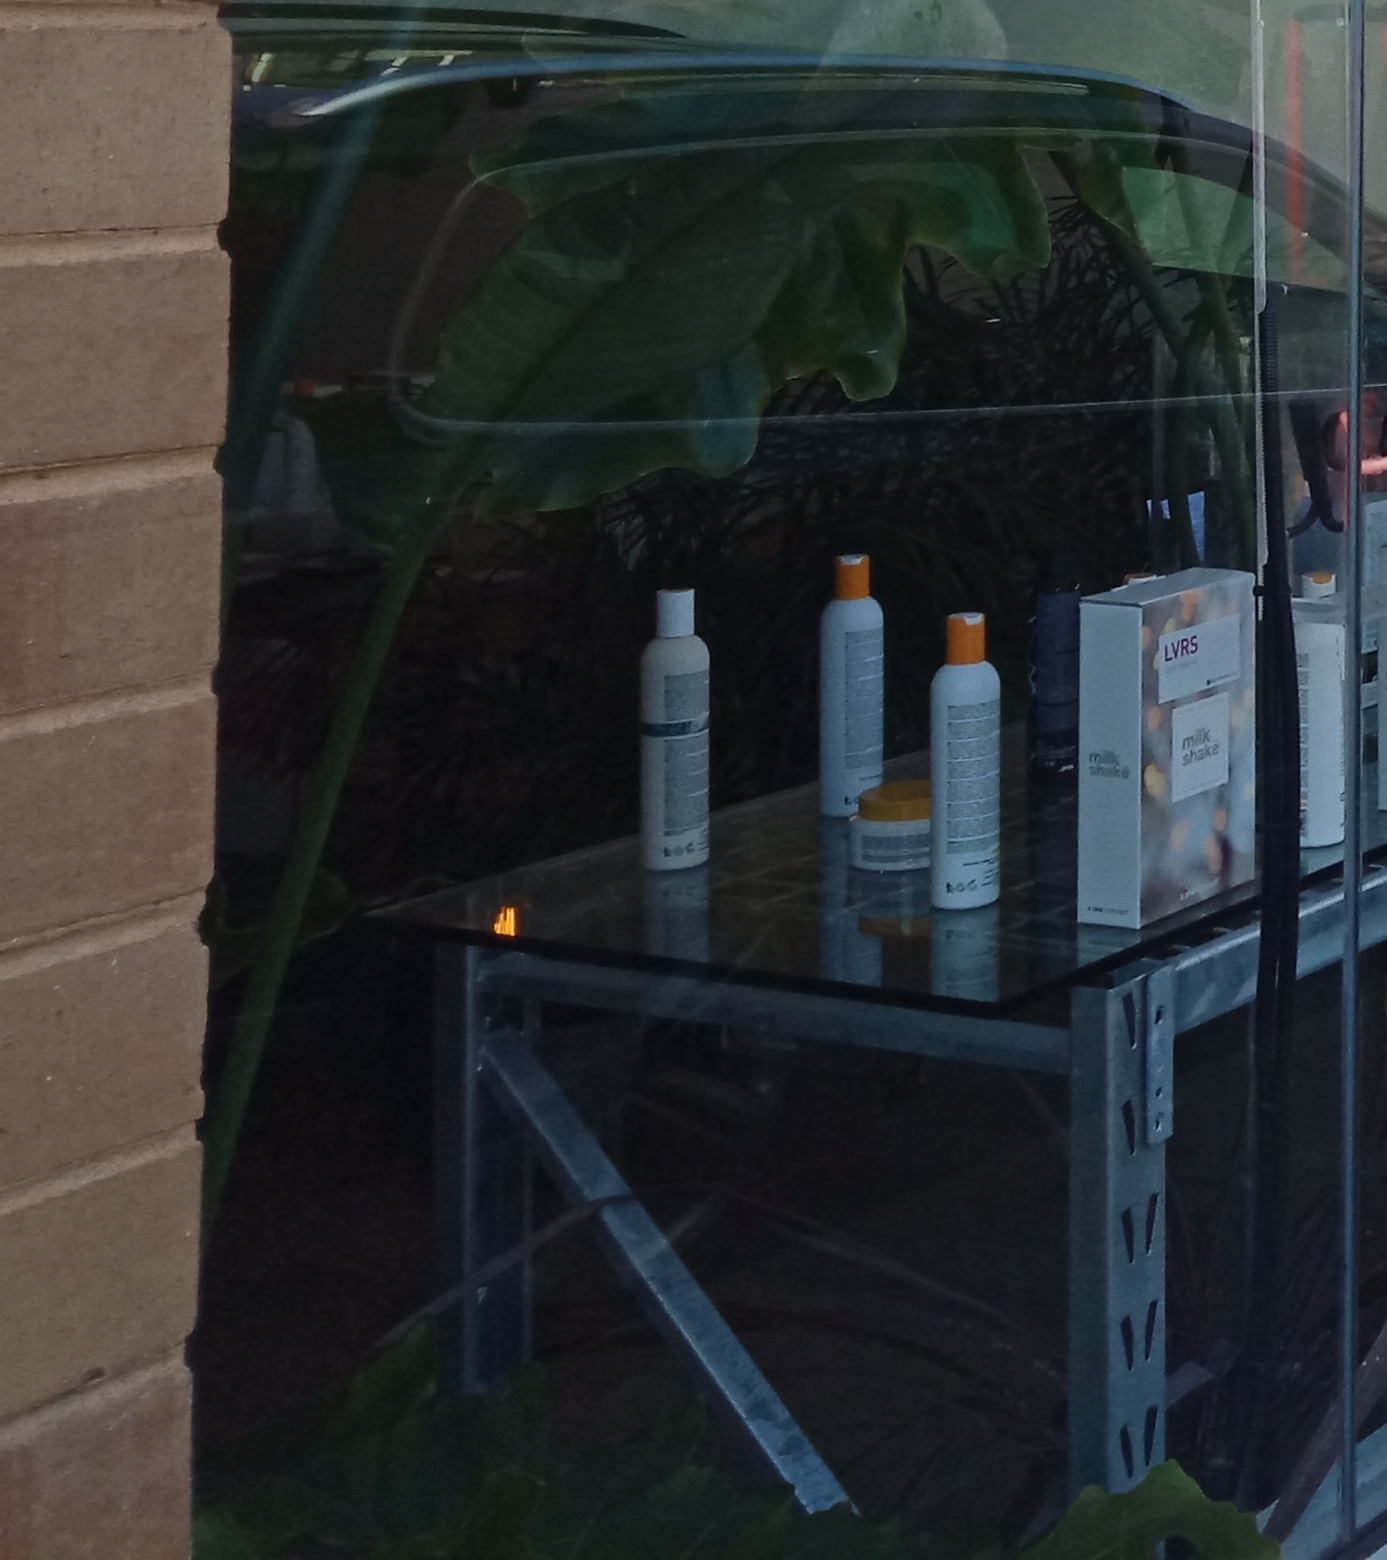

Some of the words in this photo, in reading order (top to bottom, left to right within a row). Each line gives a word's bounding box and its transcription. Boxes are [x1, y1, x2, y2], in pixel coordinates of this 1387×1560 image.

[1164, 635, 1198, 662] LVRS
[1182, 727, 1210, 751] milk
[1182, 743, 1219, 766] shake
